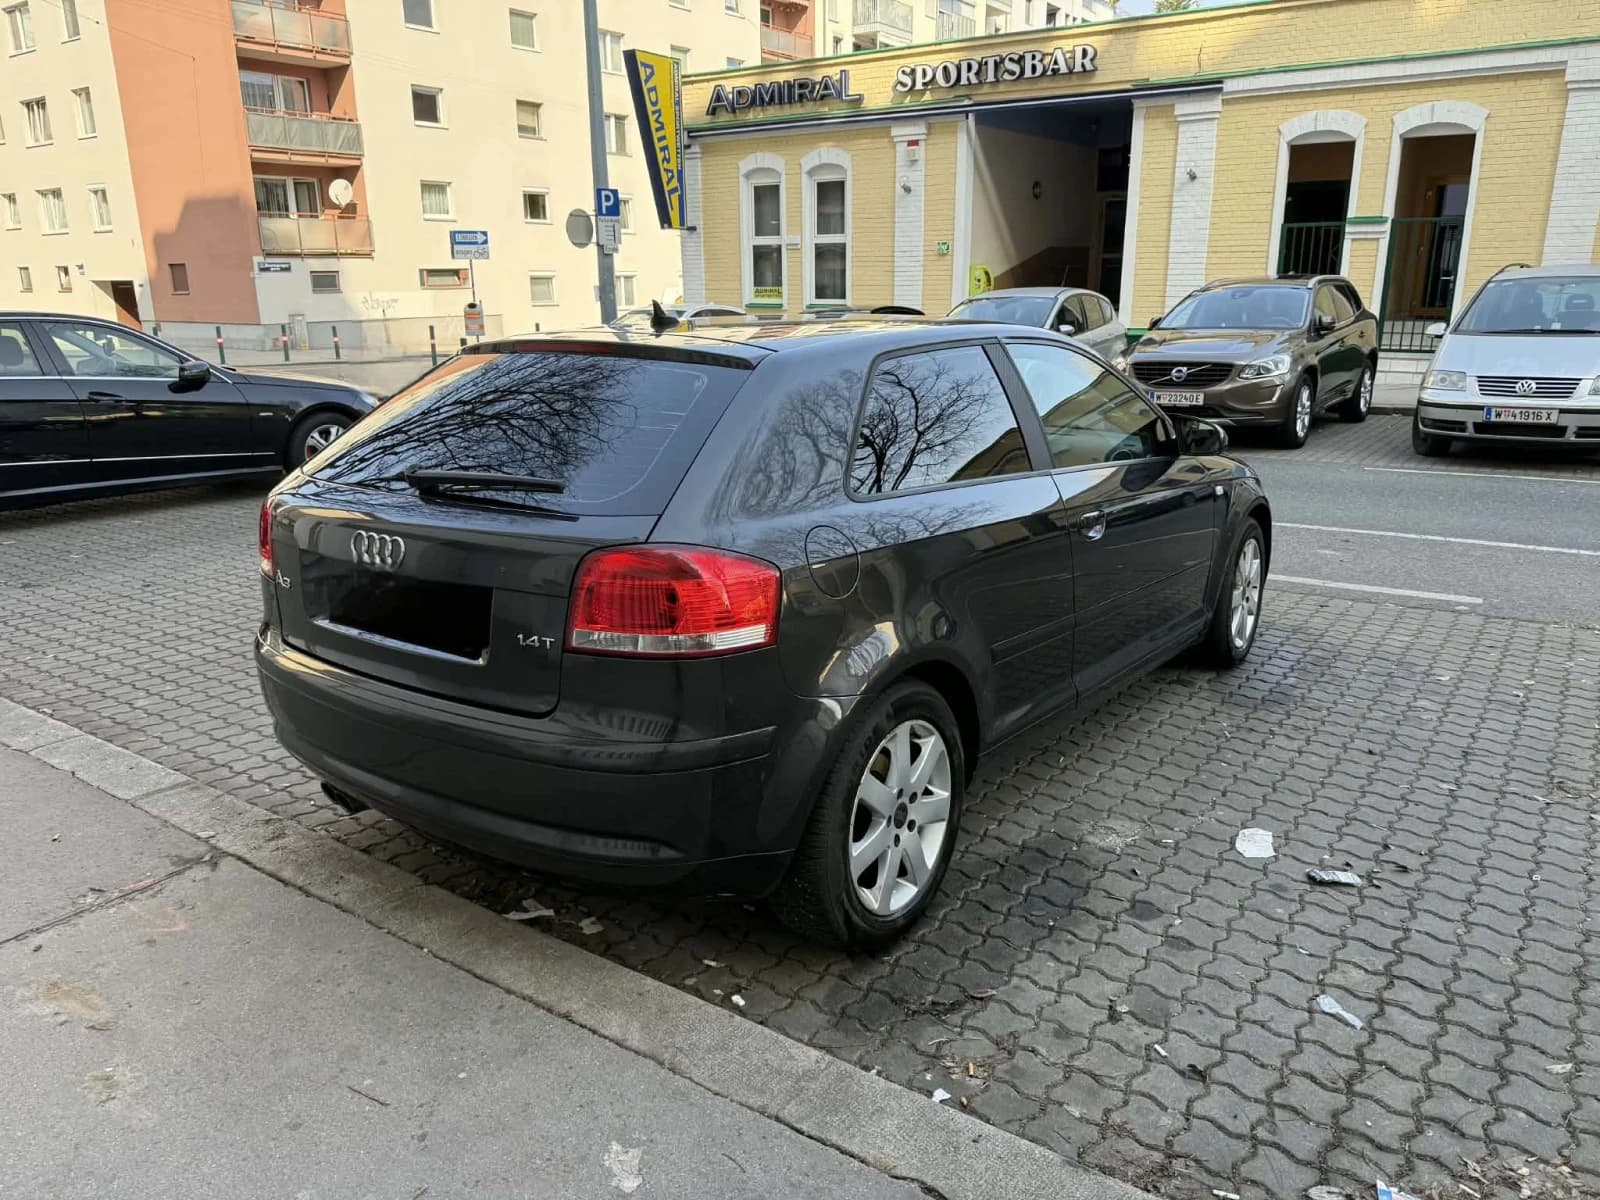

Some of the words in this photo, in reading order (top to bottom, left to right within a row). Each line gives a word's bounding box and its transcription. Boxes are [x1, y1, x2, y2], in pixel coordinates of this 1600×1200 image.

[895, 44, 1098, 93] SPORTSBAR
[706, 69, 864, 116] ADMIRAL
[639, 60, 681, 211] ADMIRAL
[601, 190, 614, 215] P
[1495, 409, 1502, 419] W
[275, 569, 291, 589] A3
